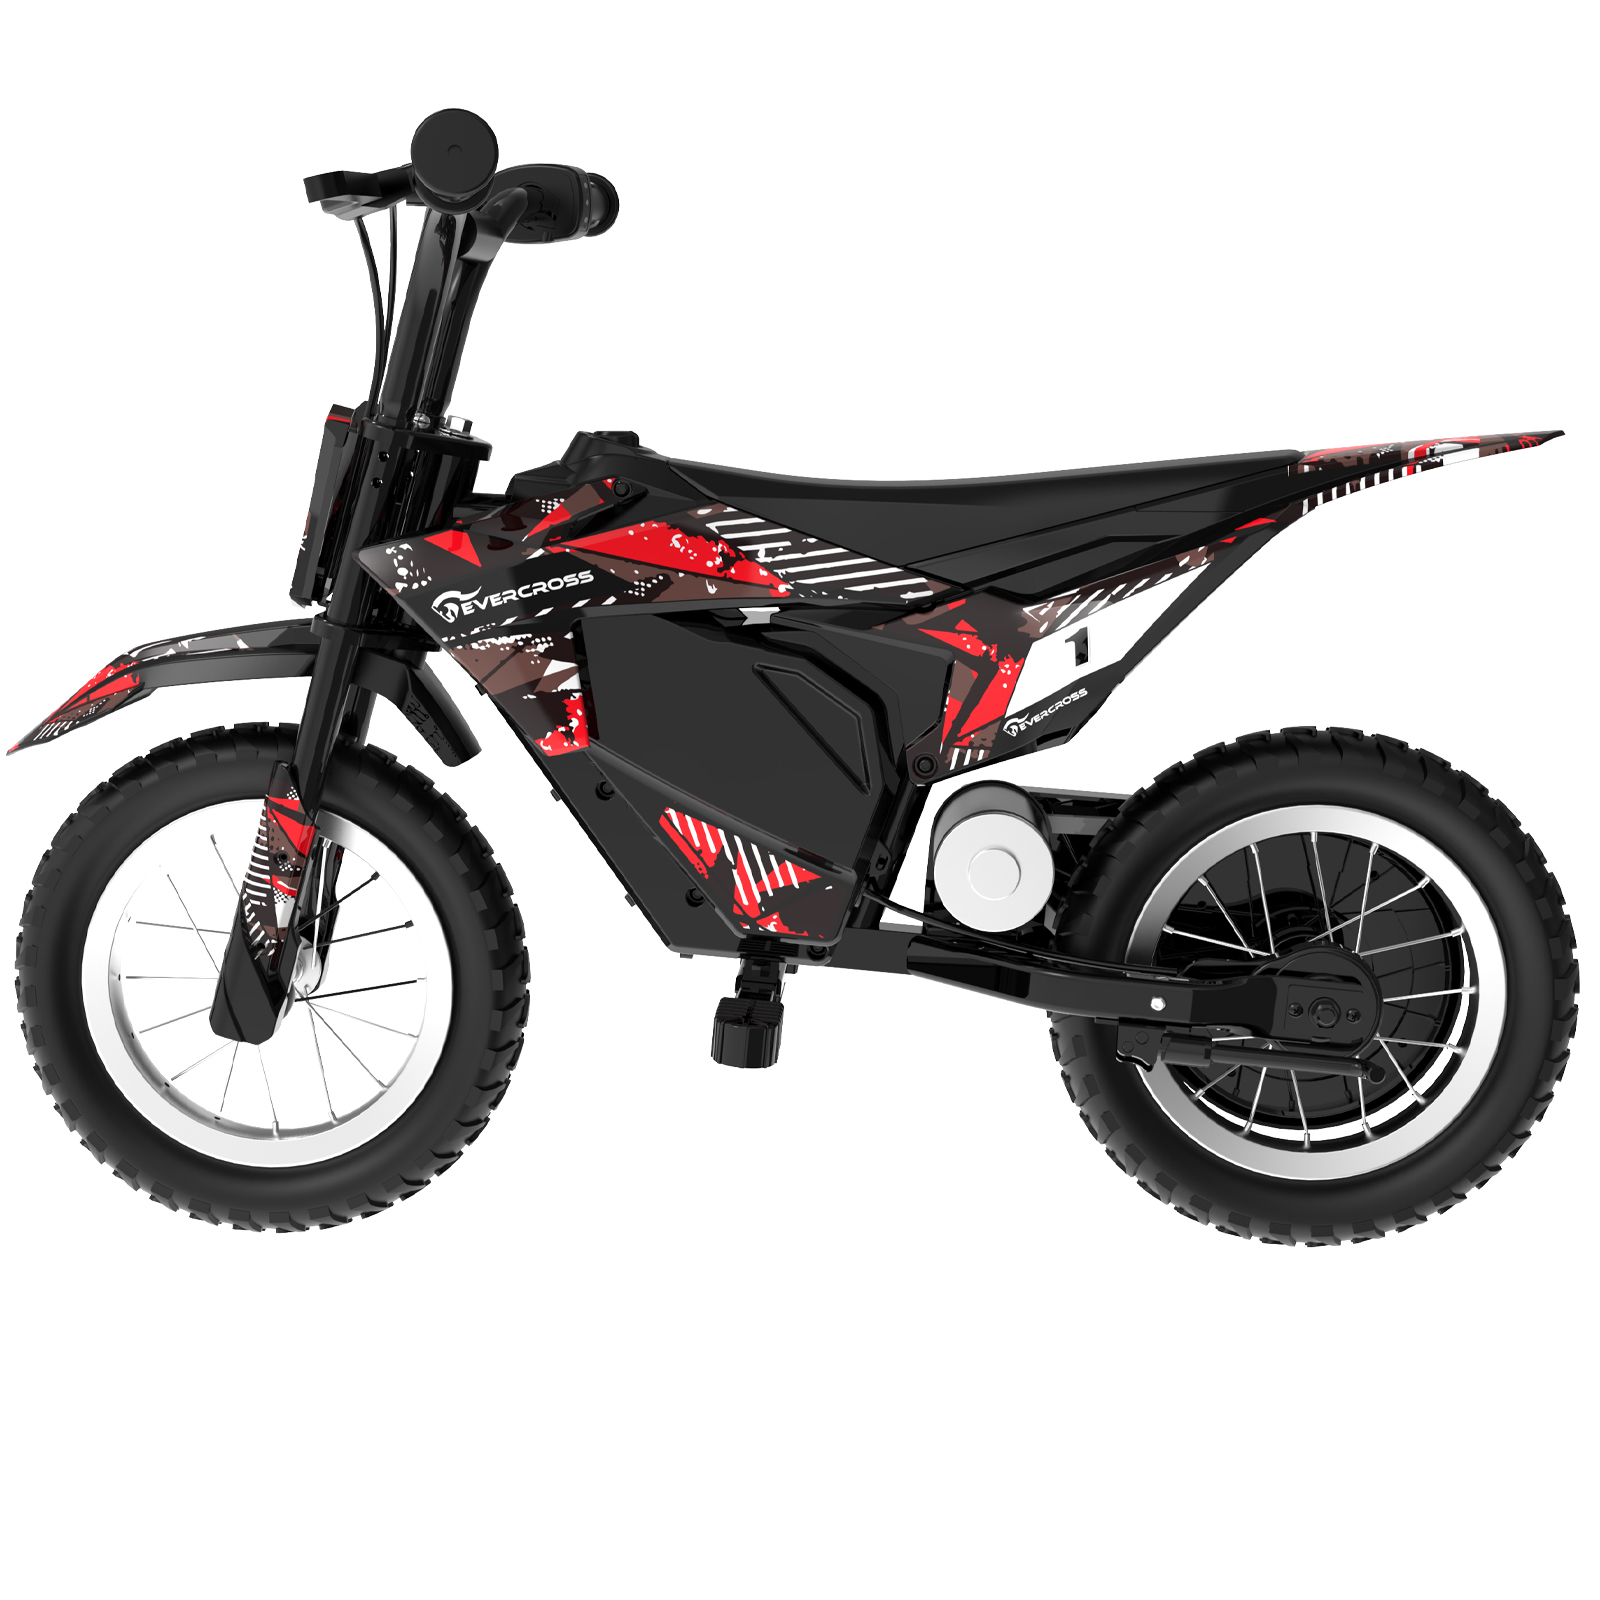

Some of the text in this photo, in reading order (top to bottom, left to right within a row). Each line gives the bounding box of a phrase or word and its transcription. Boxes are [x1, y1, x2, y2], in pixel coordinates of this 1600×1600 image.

[461, 570, 594, 615] EVERCROSS
[1065, 626, 1089, 667] 1
[1019, 688, 1088, 732] EVERCROSS
